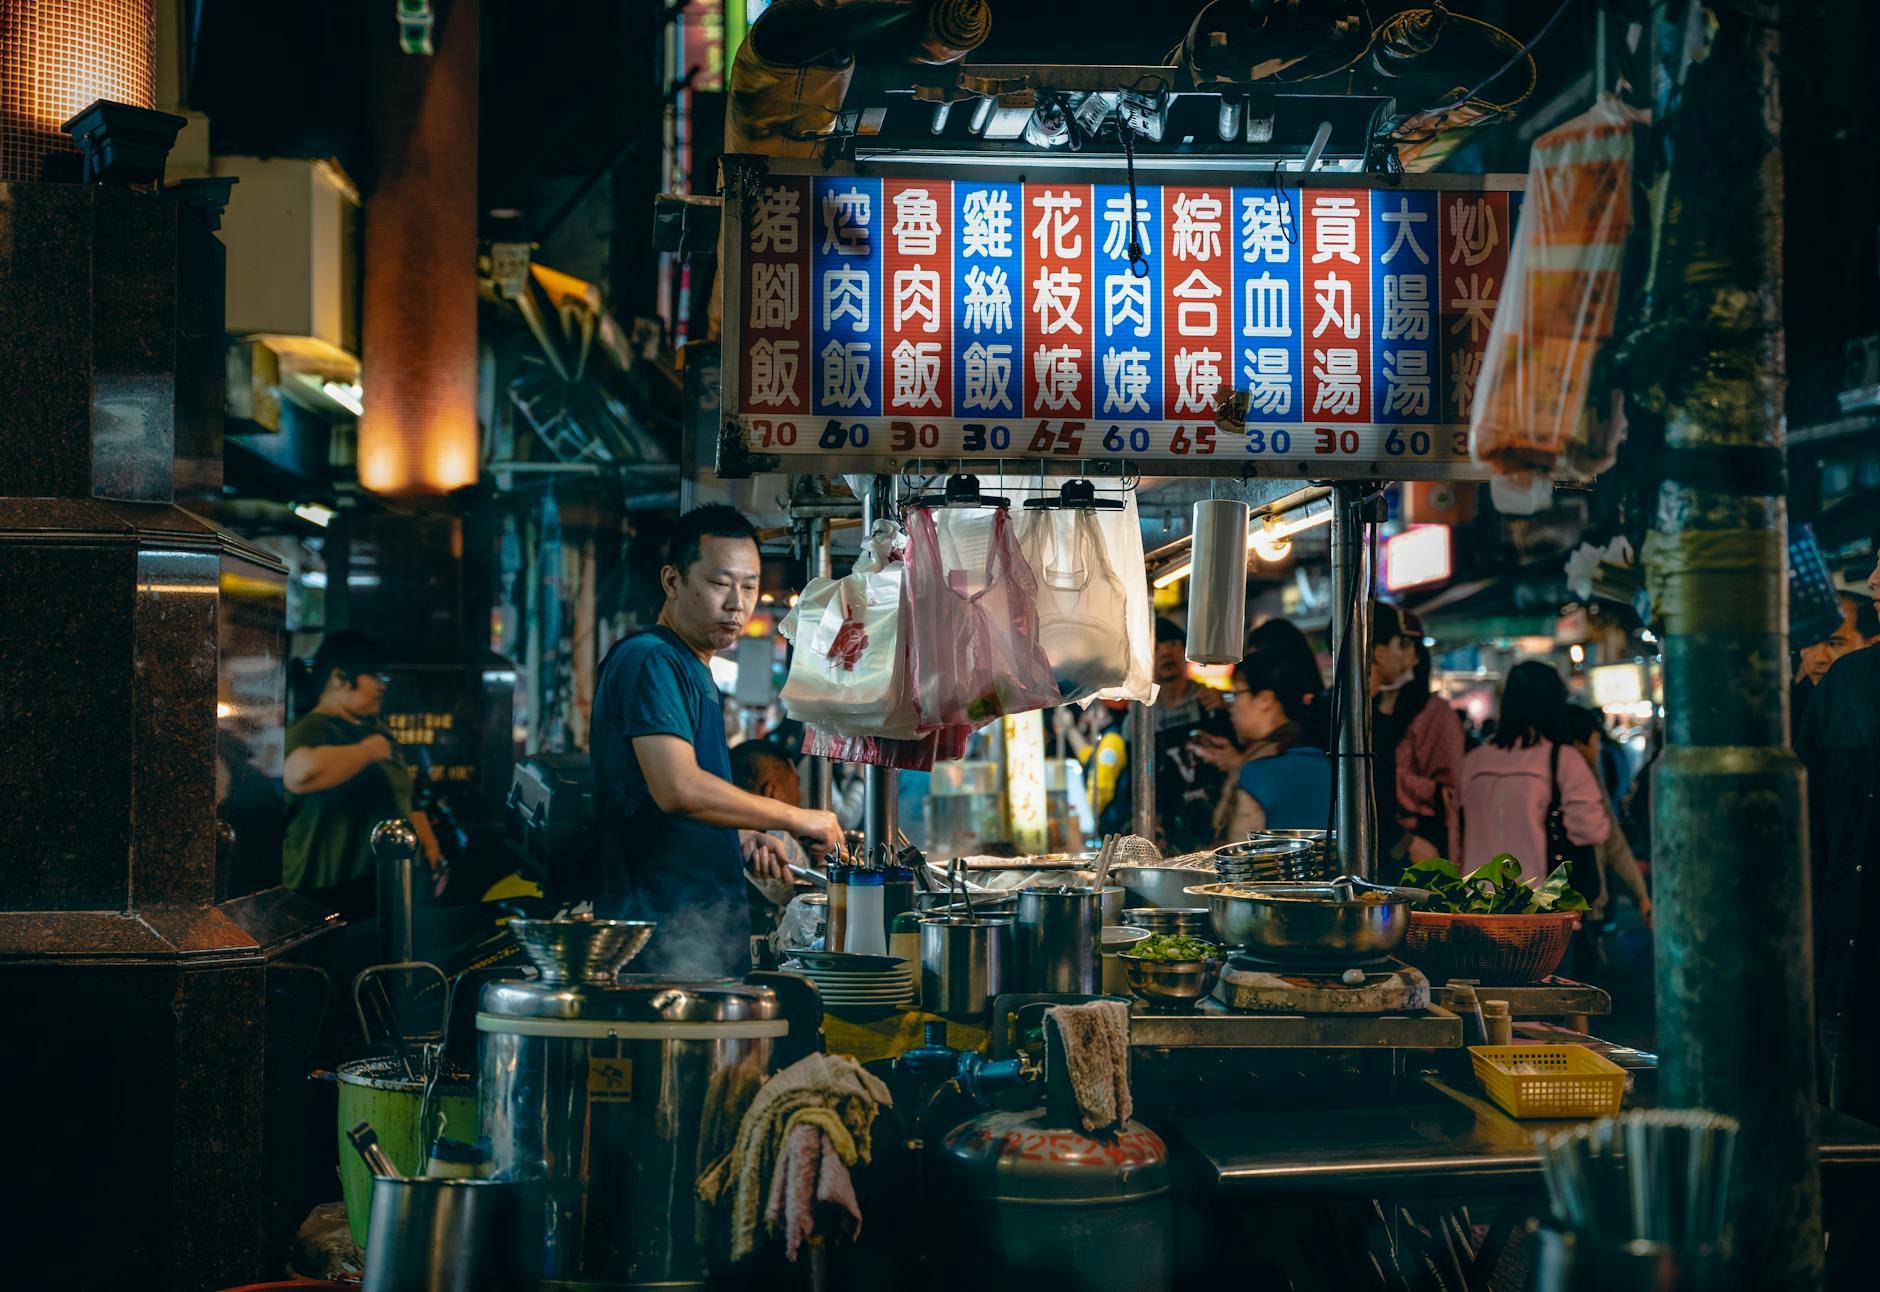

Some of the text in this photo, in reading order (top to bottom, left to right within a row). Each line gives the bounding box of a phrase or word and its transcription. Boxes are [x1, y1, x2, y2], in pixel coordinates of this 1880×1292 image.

[821, 186, 873, 409] 焢肉飯
[891, 188, 943, 409] 魯肉飯
[962, 189, 1013, 411] 雞絲飯
[1242, 195, 1293, 417] 豬血湯
[1311, 197, 1362, 417] 貢丸湯
[1381, 197, 1432, 418] 大腸湯
[752, 420, 799, 449] 70
[818, 419, 870, 450] 60
[890, 423, 940, 452] 30
[962, 423, 1011, 452] 30
[1027, 419, 1086, 456] 65
[1102, 425, 1151, 453] 60
[1169, 426, 1217, 455] 65
[1245, 429, 1292, 455] 30
[1314, 427, 1361, 455] 30
[1385, 427, 1432, 456] 60
[1450, 431, 1470, 456] 3
